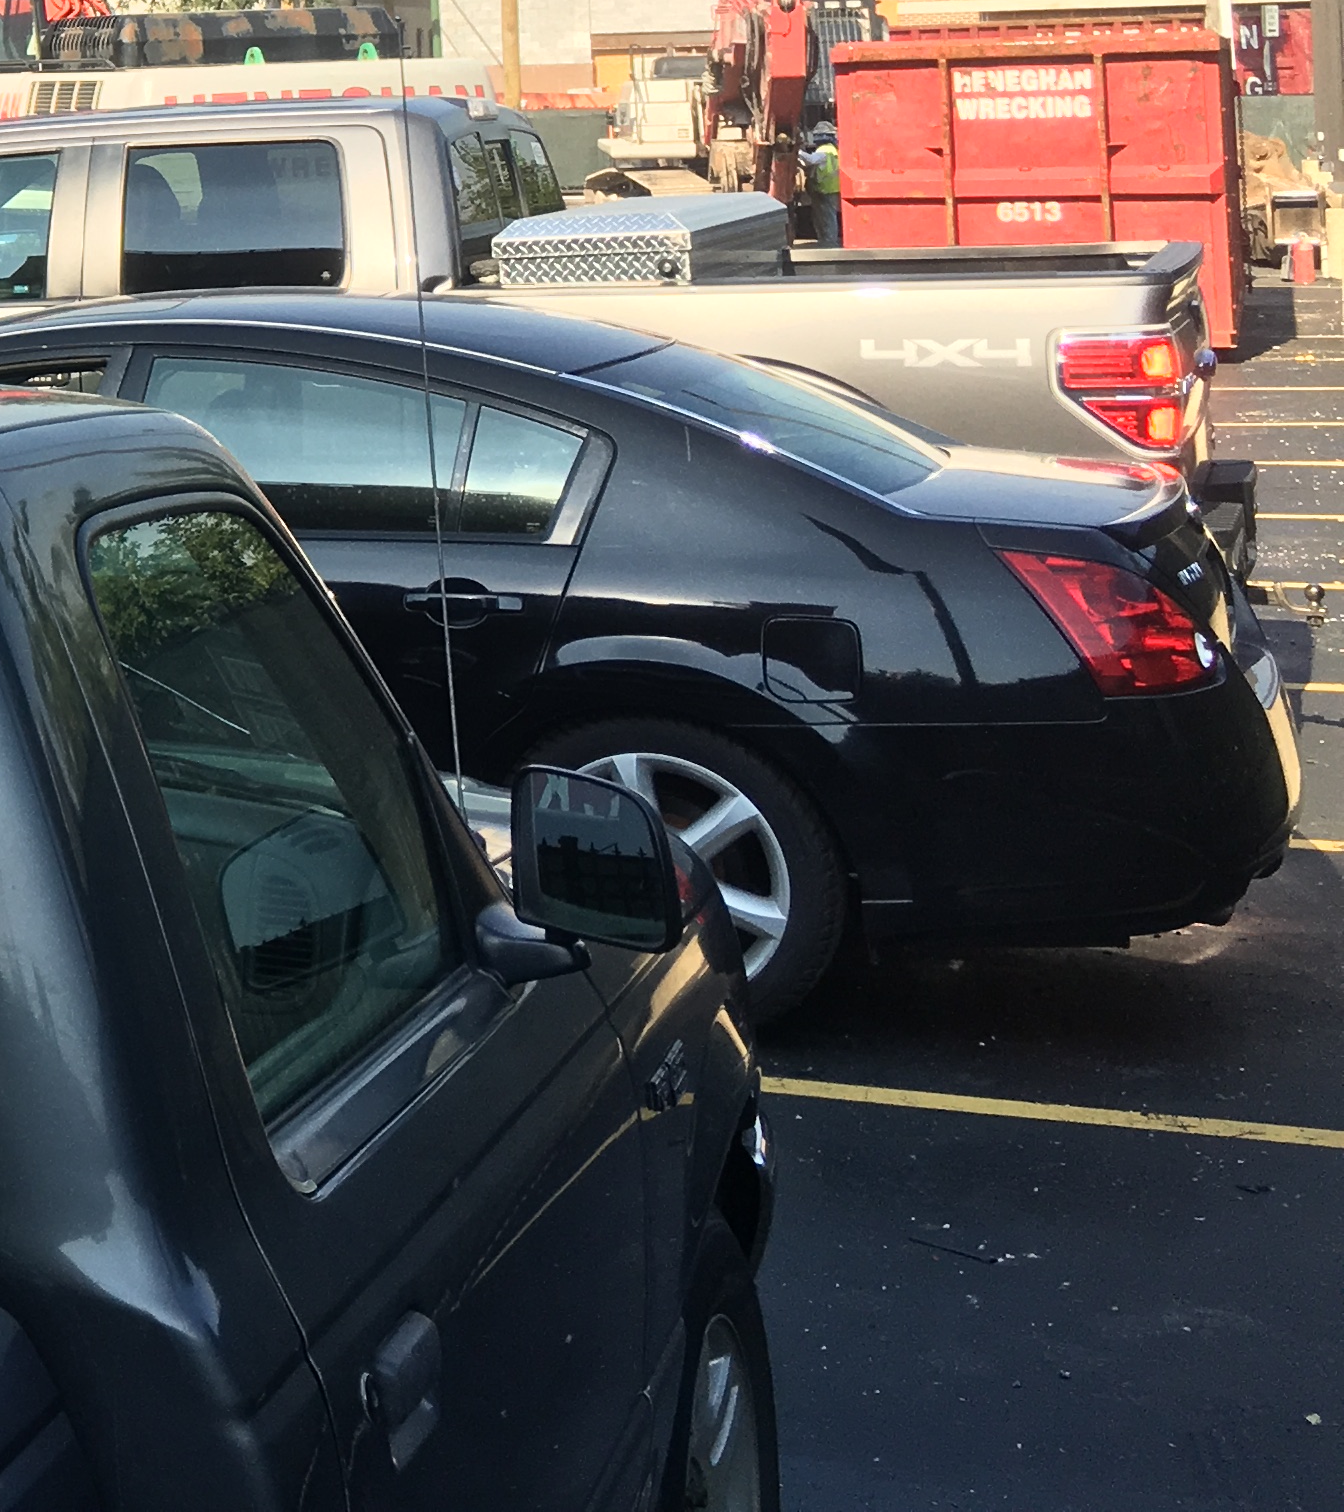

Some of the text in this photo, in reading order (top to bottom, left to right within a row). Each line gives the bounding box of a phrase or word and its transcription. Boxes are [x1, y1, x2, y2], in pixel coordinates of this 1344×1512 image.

[953, 68, 1092, 93] HENEGHAN
[956, 95, 1092, 120] WRECKING
[996, 201, 1062, 223] 6513
